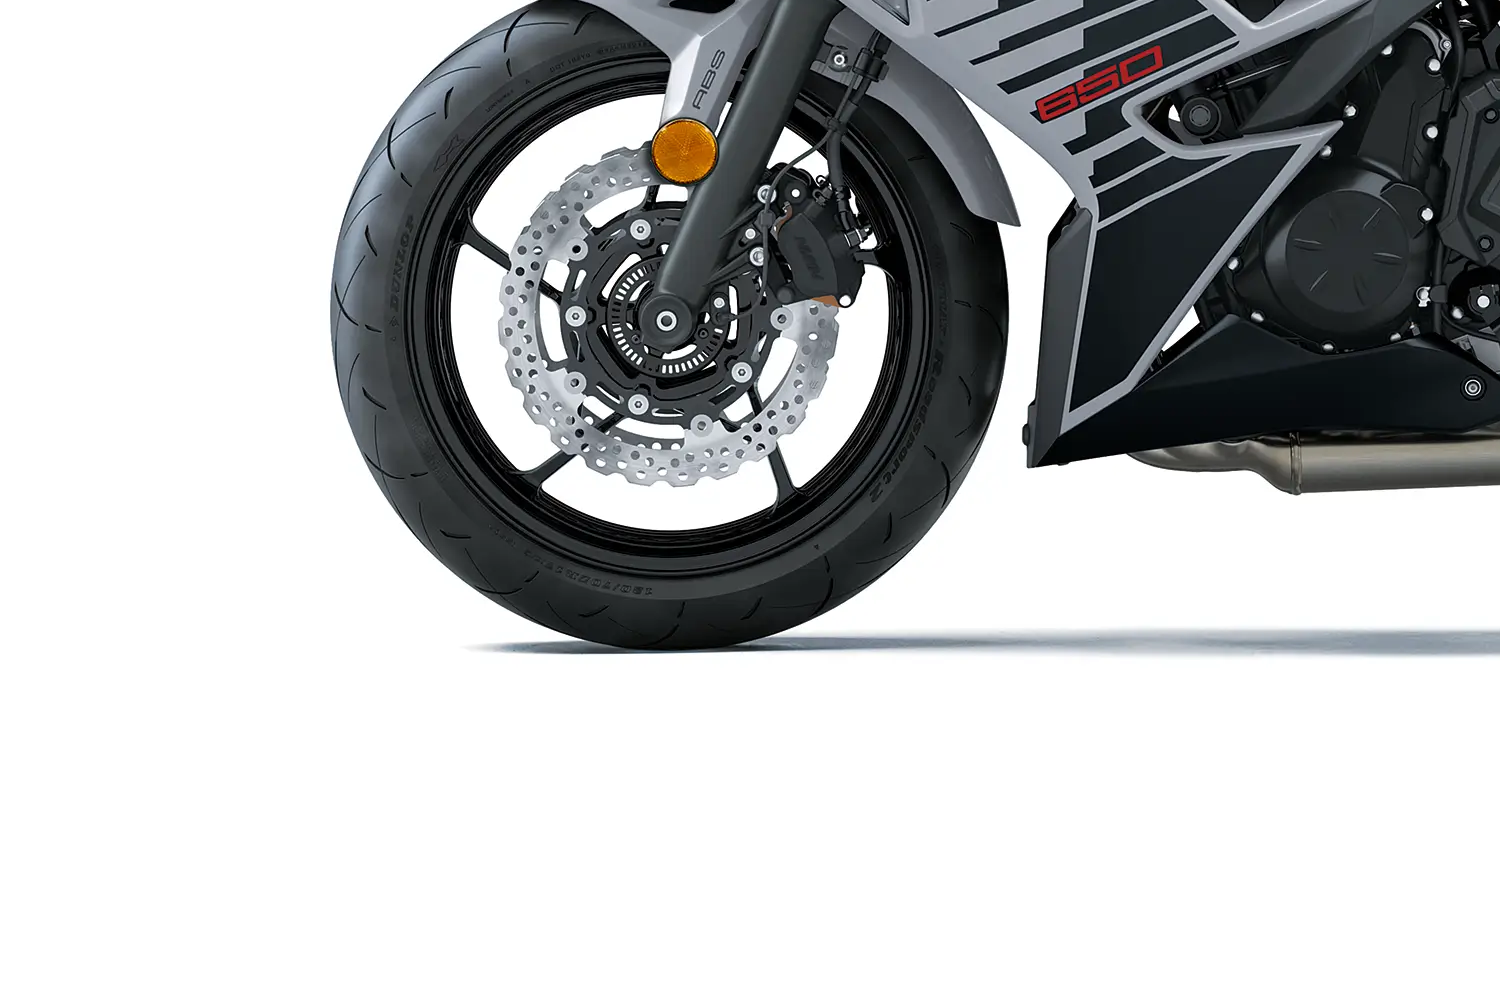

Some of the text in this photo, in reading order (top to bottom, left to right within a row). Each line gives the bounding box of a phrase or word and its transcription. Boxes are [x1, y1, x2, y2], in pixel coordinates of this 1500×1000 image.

[692, 49, 726, 110] ABS
[1034, 44, 1164, 123] 650
[391, 215, 415, 312] DUNLOP
